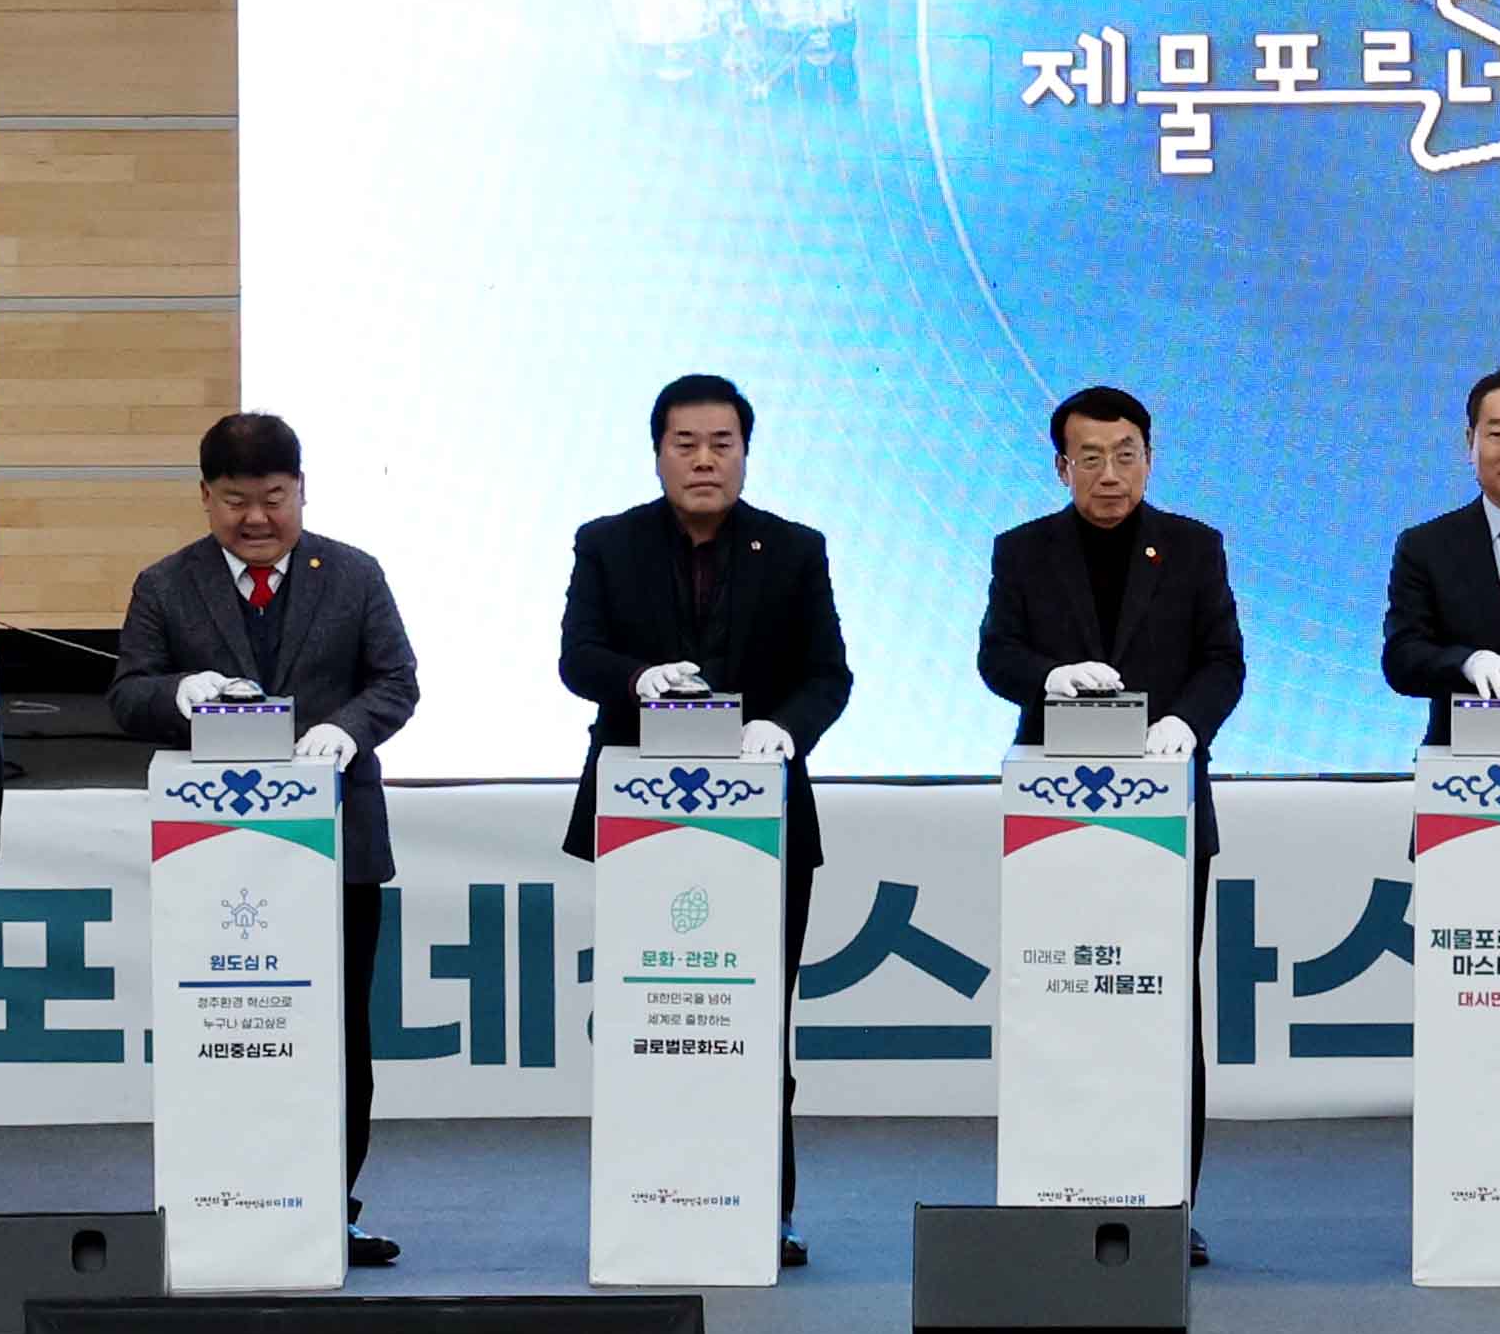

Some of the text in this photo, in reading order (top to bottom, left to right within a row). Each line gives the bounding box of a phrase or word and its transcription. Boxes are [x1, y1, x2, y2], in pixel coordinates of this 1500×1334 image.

[724, 953, 736, 967] R
[1023, 945, 1121, 965] 미래로 출항!
[210, 955, 278, 971] 원도심 R
[1046, 975, 1163, 995] 세계로 제물포!
[647, 993, 704, 1005] 대한민국을
[204, 1018, 237, 1029] 누구나
[198, 1043, 293, 1058] 시민중심도시
[633, 1039, 744, 1055] 글로벌문화도시
